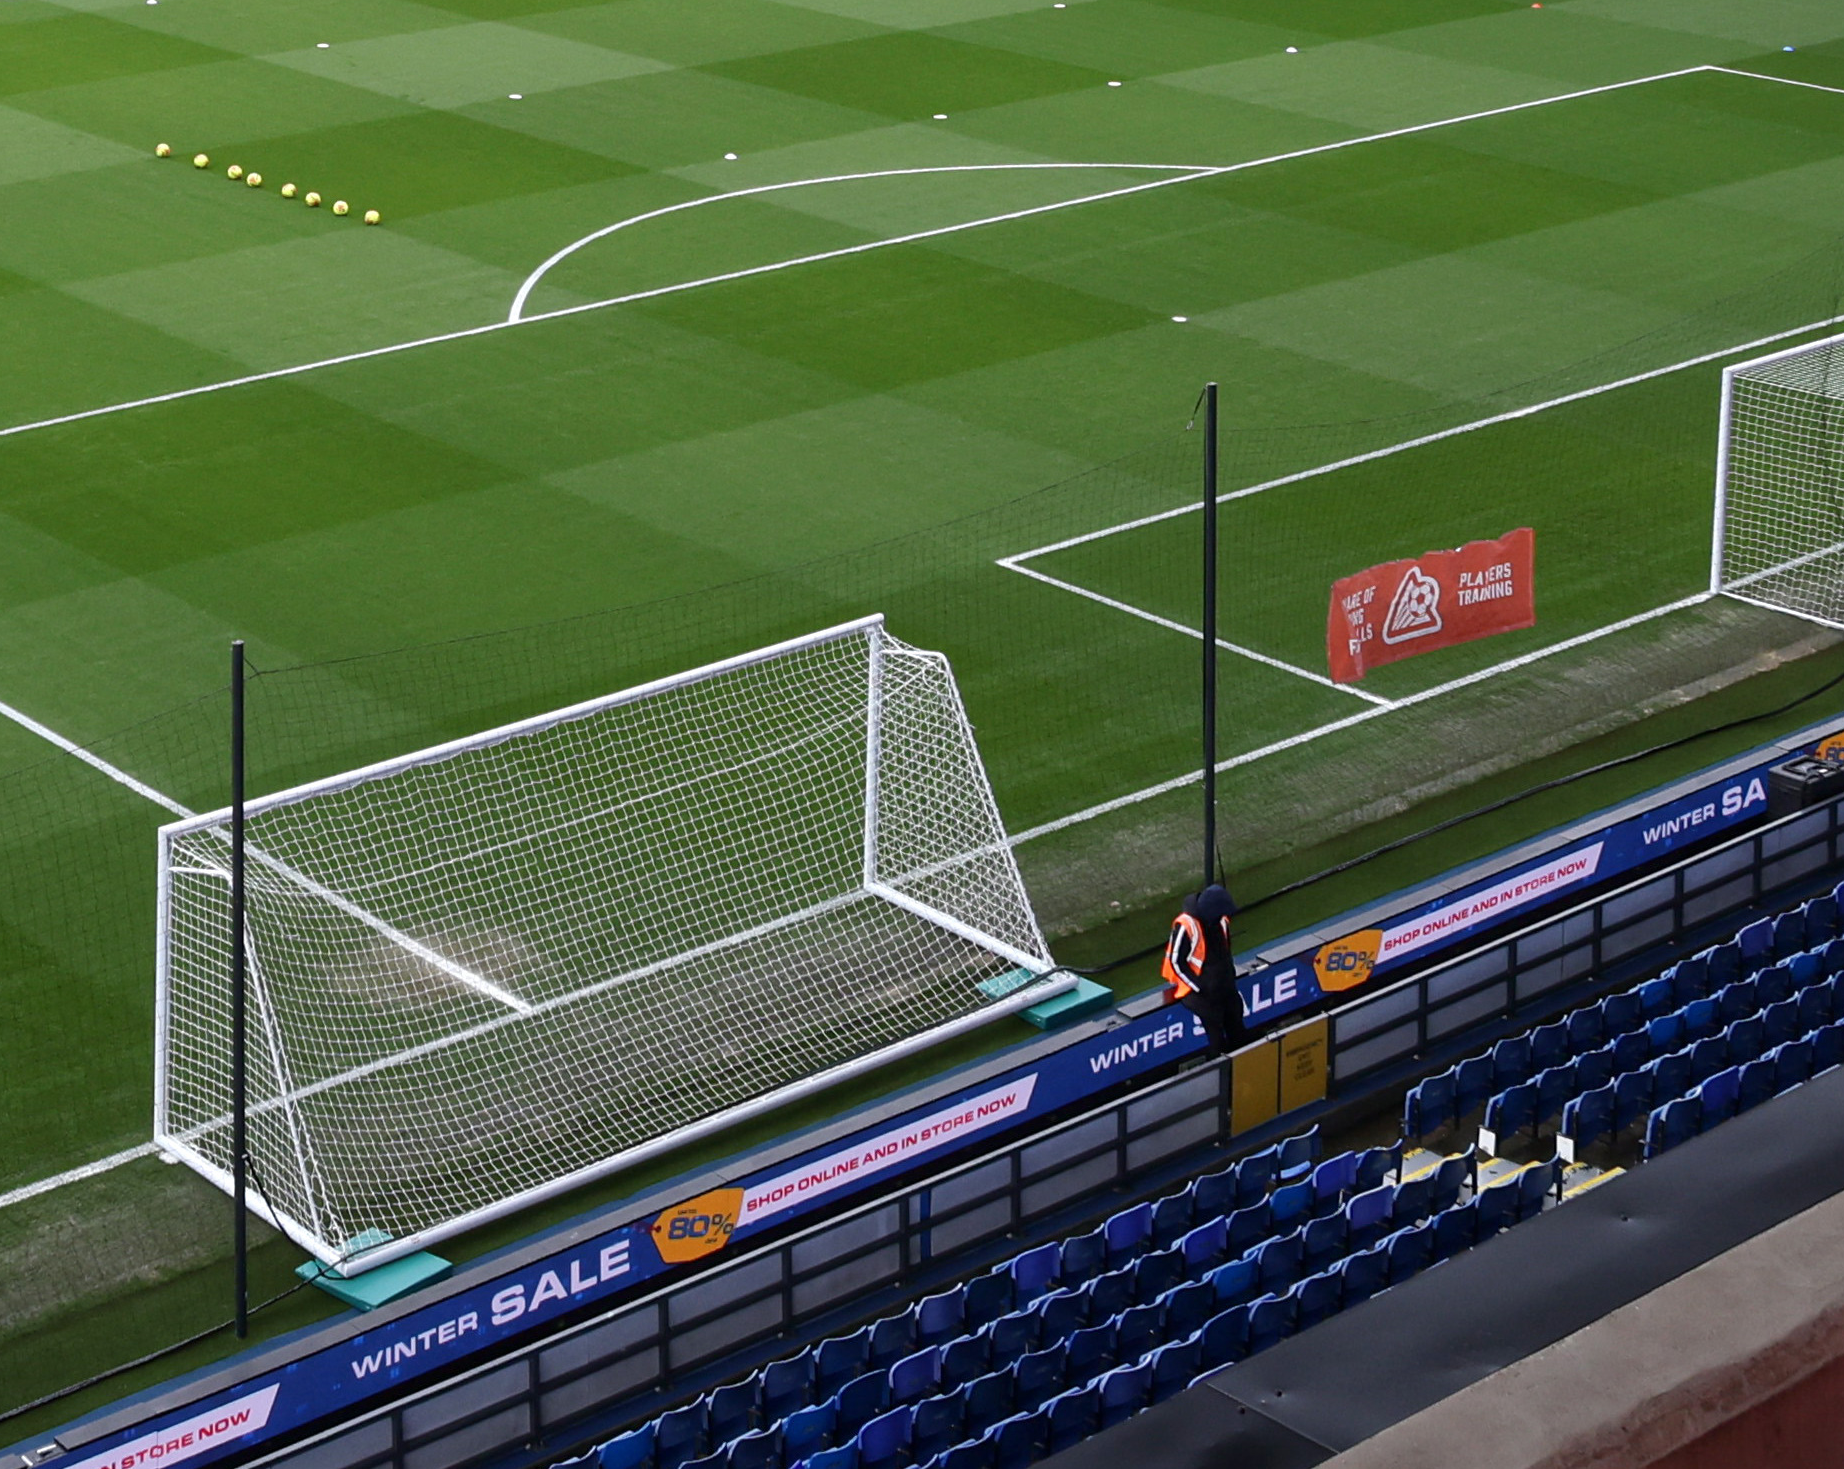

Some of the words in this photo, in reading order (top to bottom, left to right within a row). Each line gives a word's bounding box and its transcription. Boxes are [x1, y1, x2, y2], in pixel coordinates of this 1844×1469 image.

[1364, 585, 1376, 604] OF
[1458, 581, 1513, 606] TRAINING
[1642, 802, 1716, 846] WINTER
[1721, 775, 1766, 816] SA
[1384, 929, 1421, 952] SHOP
[1422, 908, 1469, 936] ONLINE
[1470, 894, 1499, 917] AND
[1500, 890, 1514, 904] IN
[1515, 871, 1556, 896] STORE
[1557, 858, 1588, 879] NOW
[1325, 950, 1377, 972] 80%
[1089, 1021, 1184, 1074] WINTER
[1193, 967, 1299, 1038] SLE
[746, 1183, 795, 1213] SHOP
[797, 1157, 860, 1192] ONLINE
[862, 1141, 899, 1166] AND
[901, 1134, 918, 1151] IN
[921, 1110, 974, 1142] STORE
[976, 1093, 1017, 1119] NOW
[668, 1212, 735, 1240] 80%
[350, 1311, 480, 1381] WINTER
[490, 1238, 632, 1327] SALE
[121, 1432, 194, 1469] STORE
[198, 1408, 251, 1442] NOW
